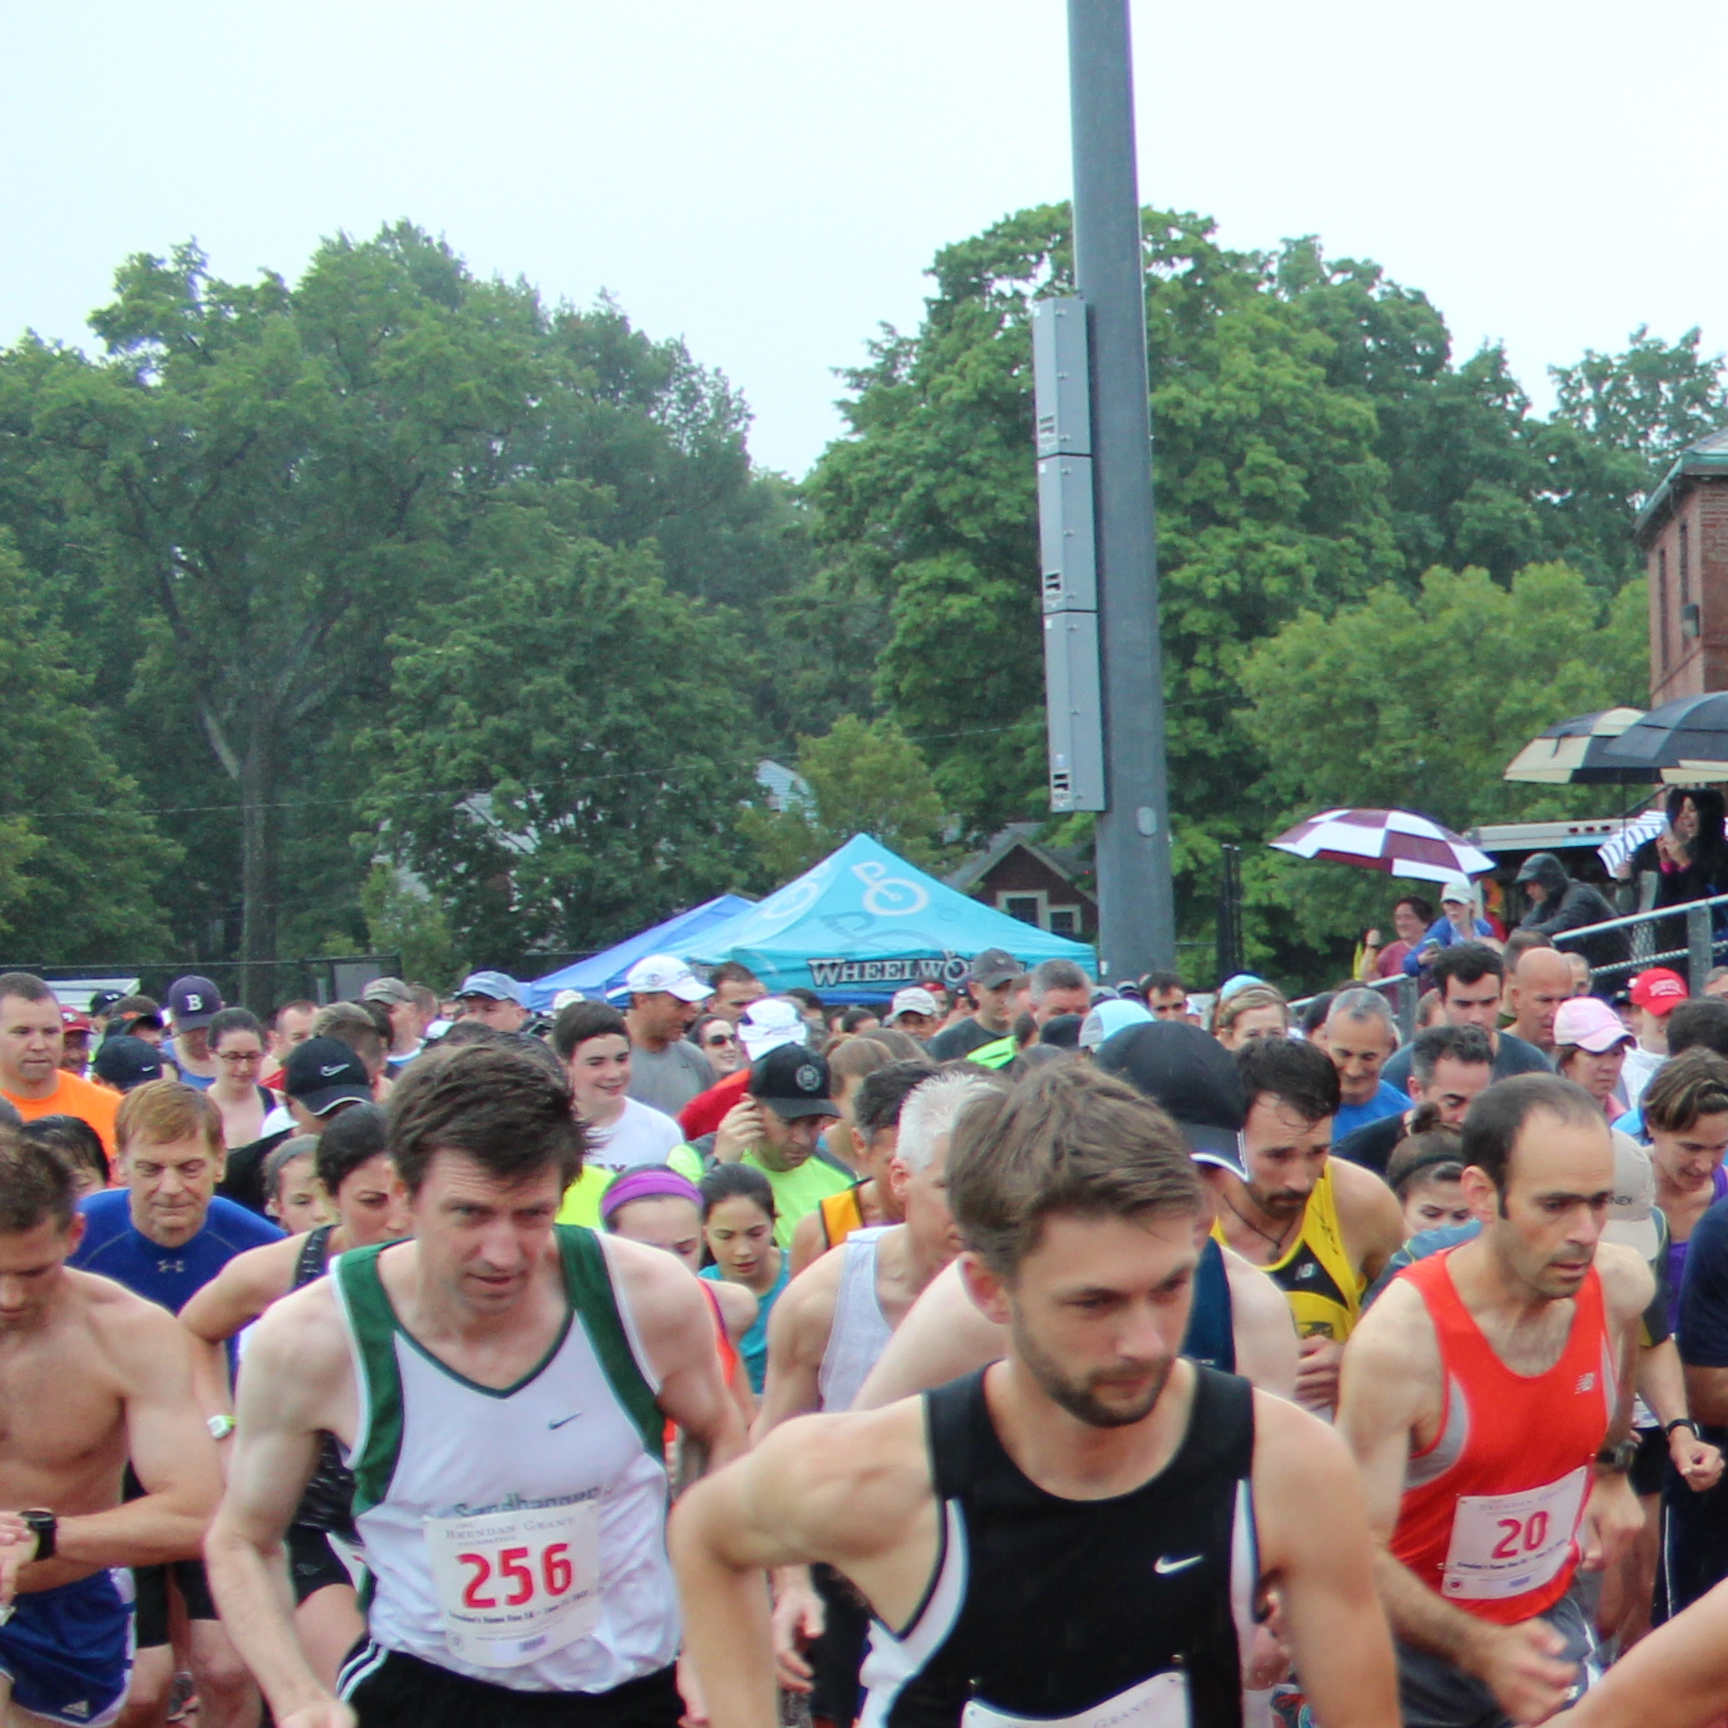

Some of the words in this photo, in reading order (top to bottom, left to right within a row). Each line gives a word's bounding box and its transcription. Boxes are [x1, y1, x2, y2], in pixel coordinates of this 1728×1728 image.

[186, 994, 204, 1012] B
[1491, 1510, 1549, 1560] 20
[455, 1543, 574, 1609] 256
